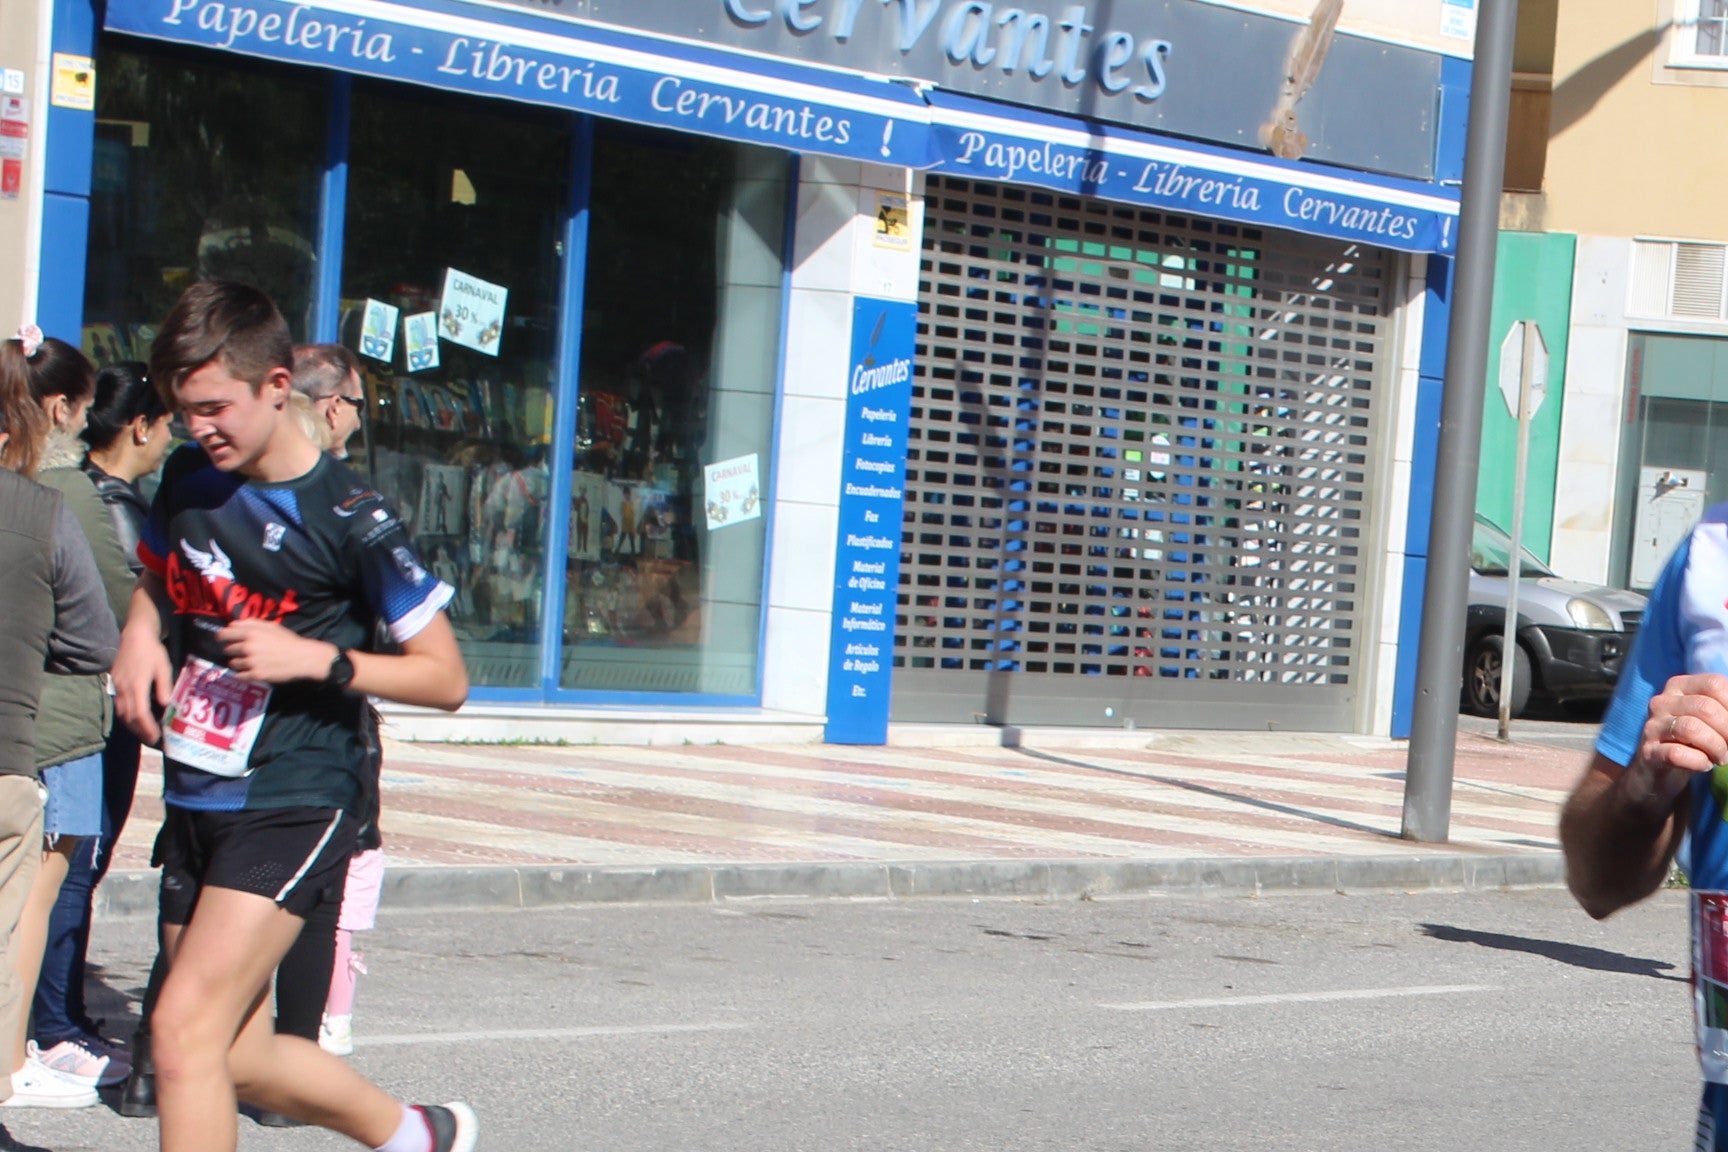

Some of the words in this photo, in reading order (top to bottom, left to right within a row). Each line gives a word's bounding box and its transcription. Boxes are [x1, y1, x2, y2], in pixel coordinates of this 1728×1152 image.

[721, 0, 1173, 101] ervantes
[7, 73, 20, 90] 15
[650, 77, 851, 145] Cervantes
[1283, 187, 1418, 240] Cervantes
[453, 279, 498, 305] CARNAVAL
[455, 304, 469, 320] 30
[852, 358, 910, 395] Cervantes
[712, 463, 752, 482] CARNAVAL
[855, 458, 896, 475] Fotocopias
[845, 483, 901, 499] Encuadernados
[864, 511, 879, 523] Fax
[847, 535, 893, 550] Plastificados
[853, 561, 885, 574] Material
[848, 577, 858, 588] de
[859, 578, 885, 591] Oficina
[850, 602, 882, 615] Material
[843, 659, 853, 671] de
[854, 660, 879, 674] Regalo
